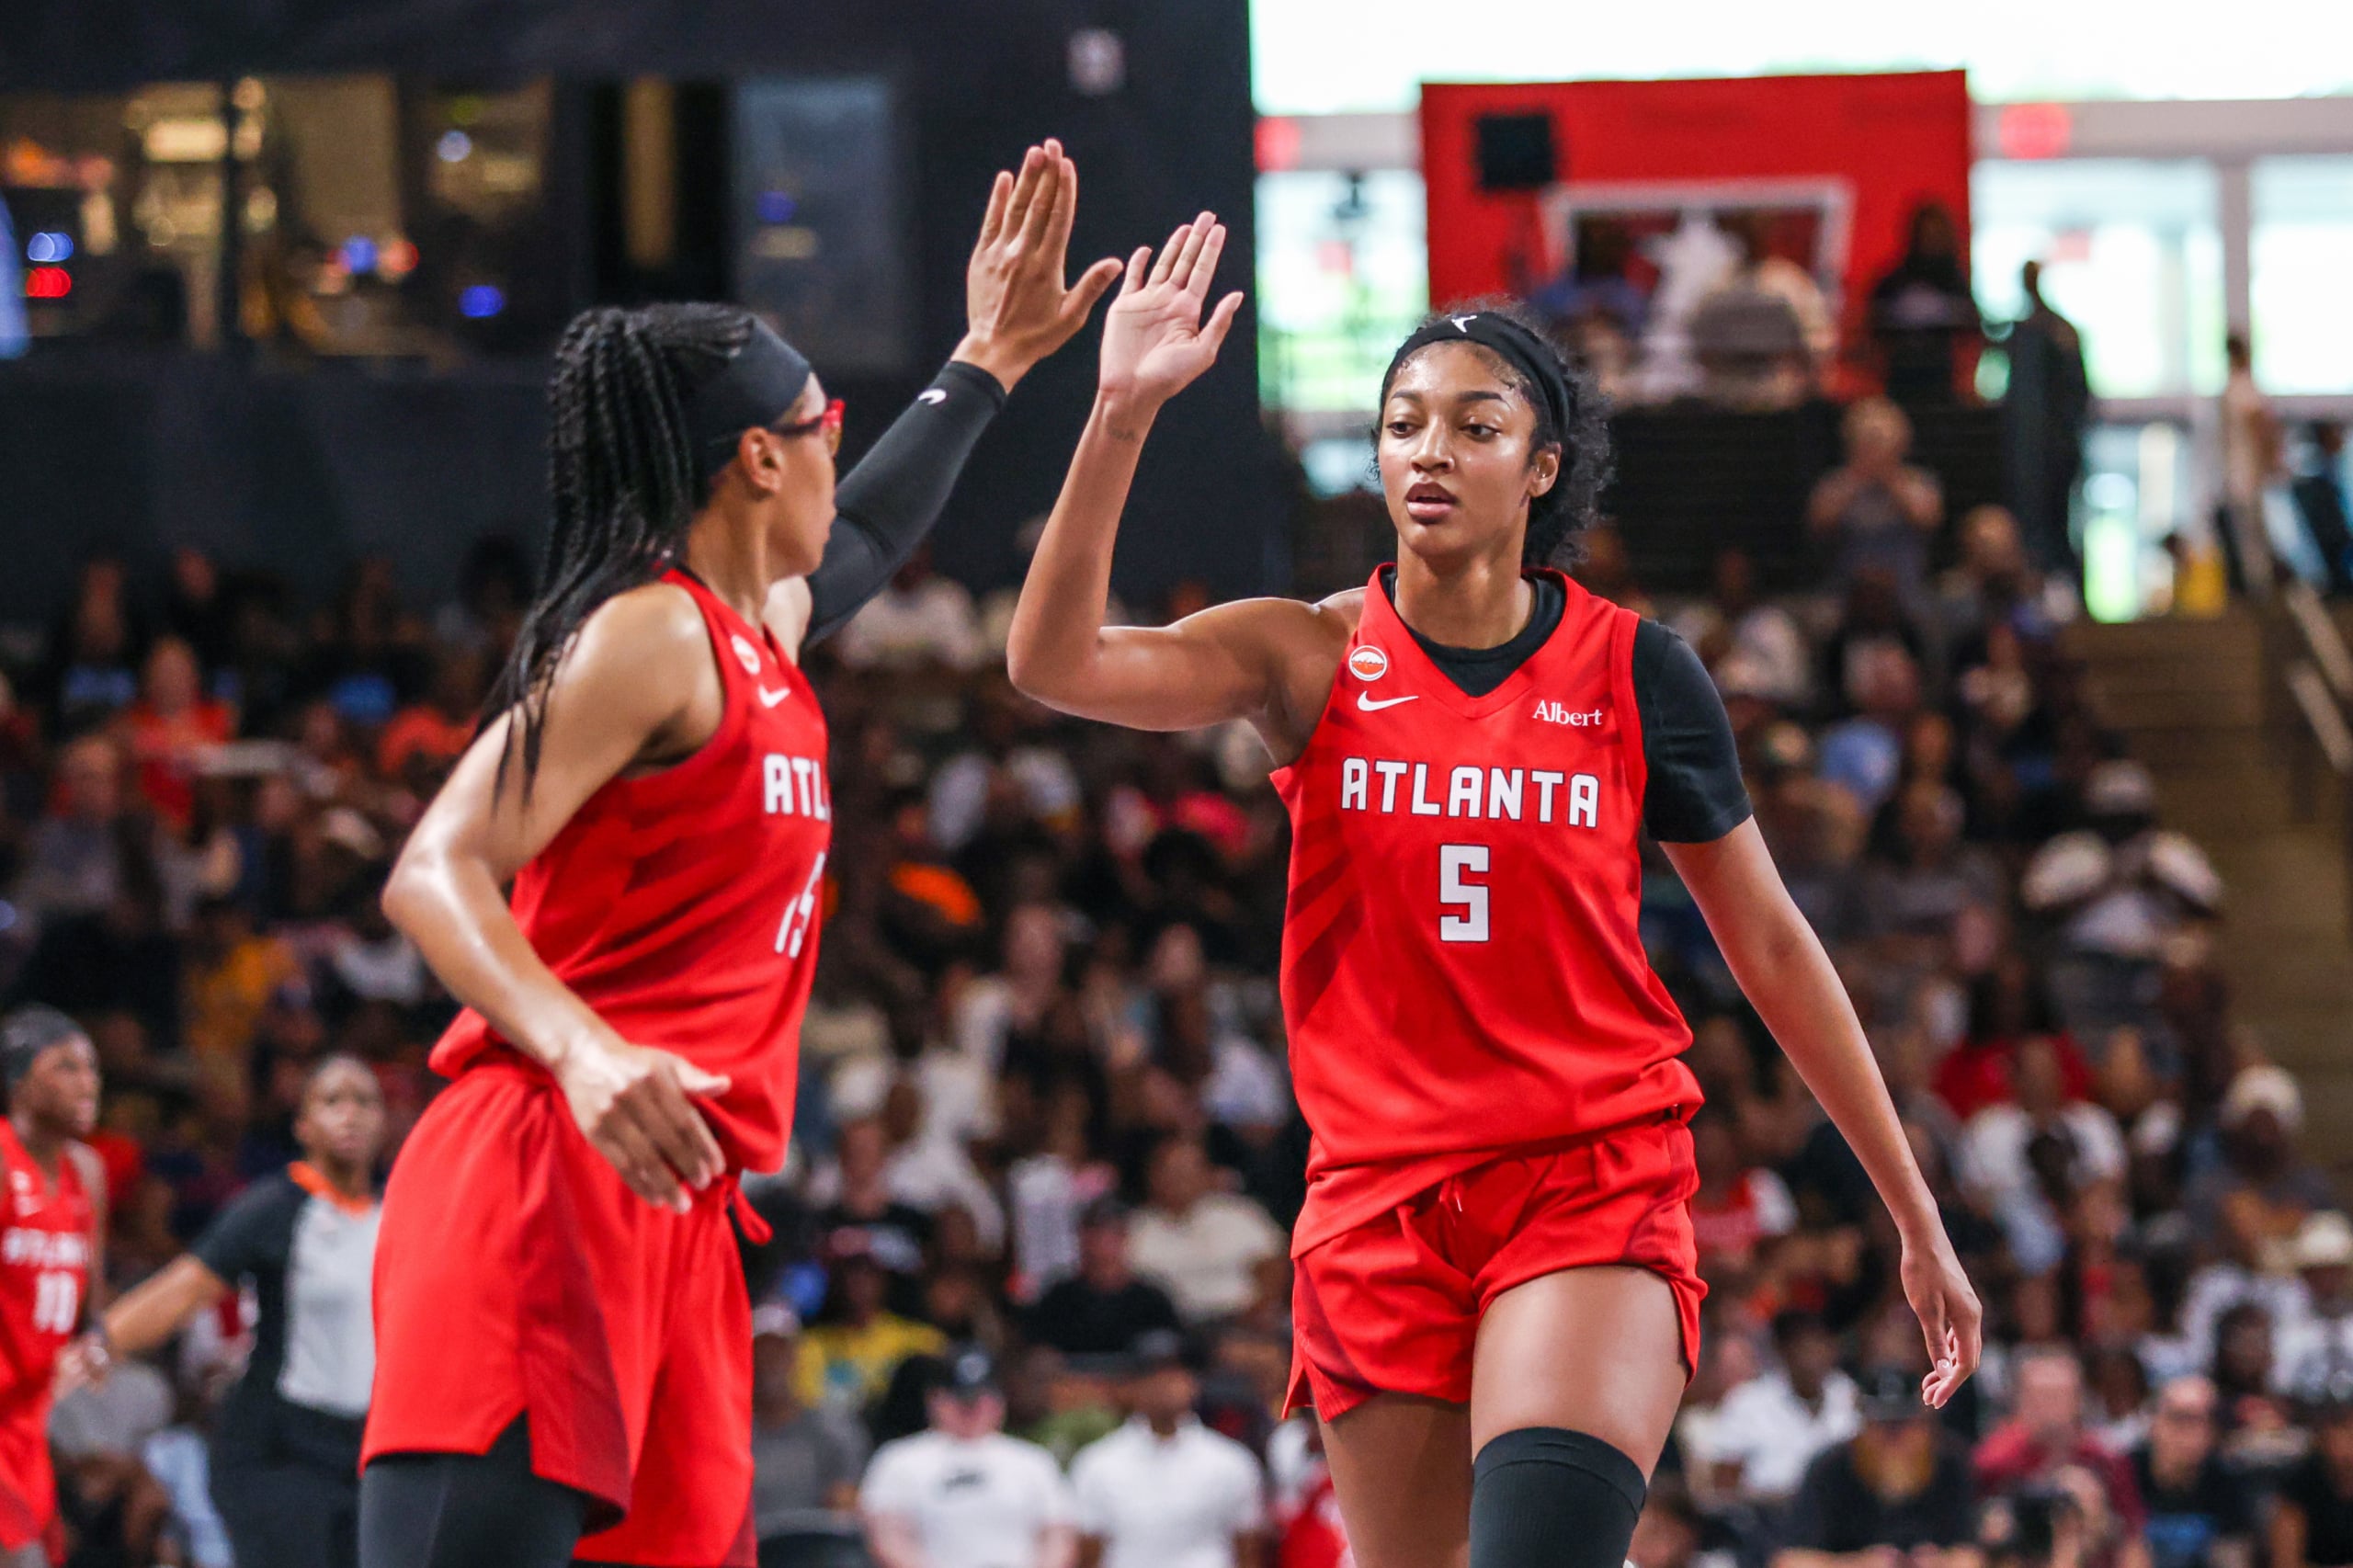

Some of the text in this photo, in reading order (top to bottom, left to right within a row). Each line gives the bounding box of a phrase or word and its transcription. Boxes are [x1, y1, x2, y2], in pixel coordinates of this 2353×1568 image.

[1532, 699, 1603, 727] Albert
[1340, 756, 1600, 828] ATLANTA
[1439, 843, 1490, 943] 5
